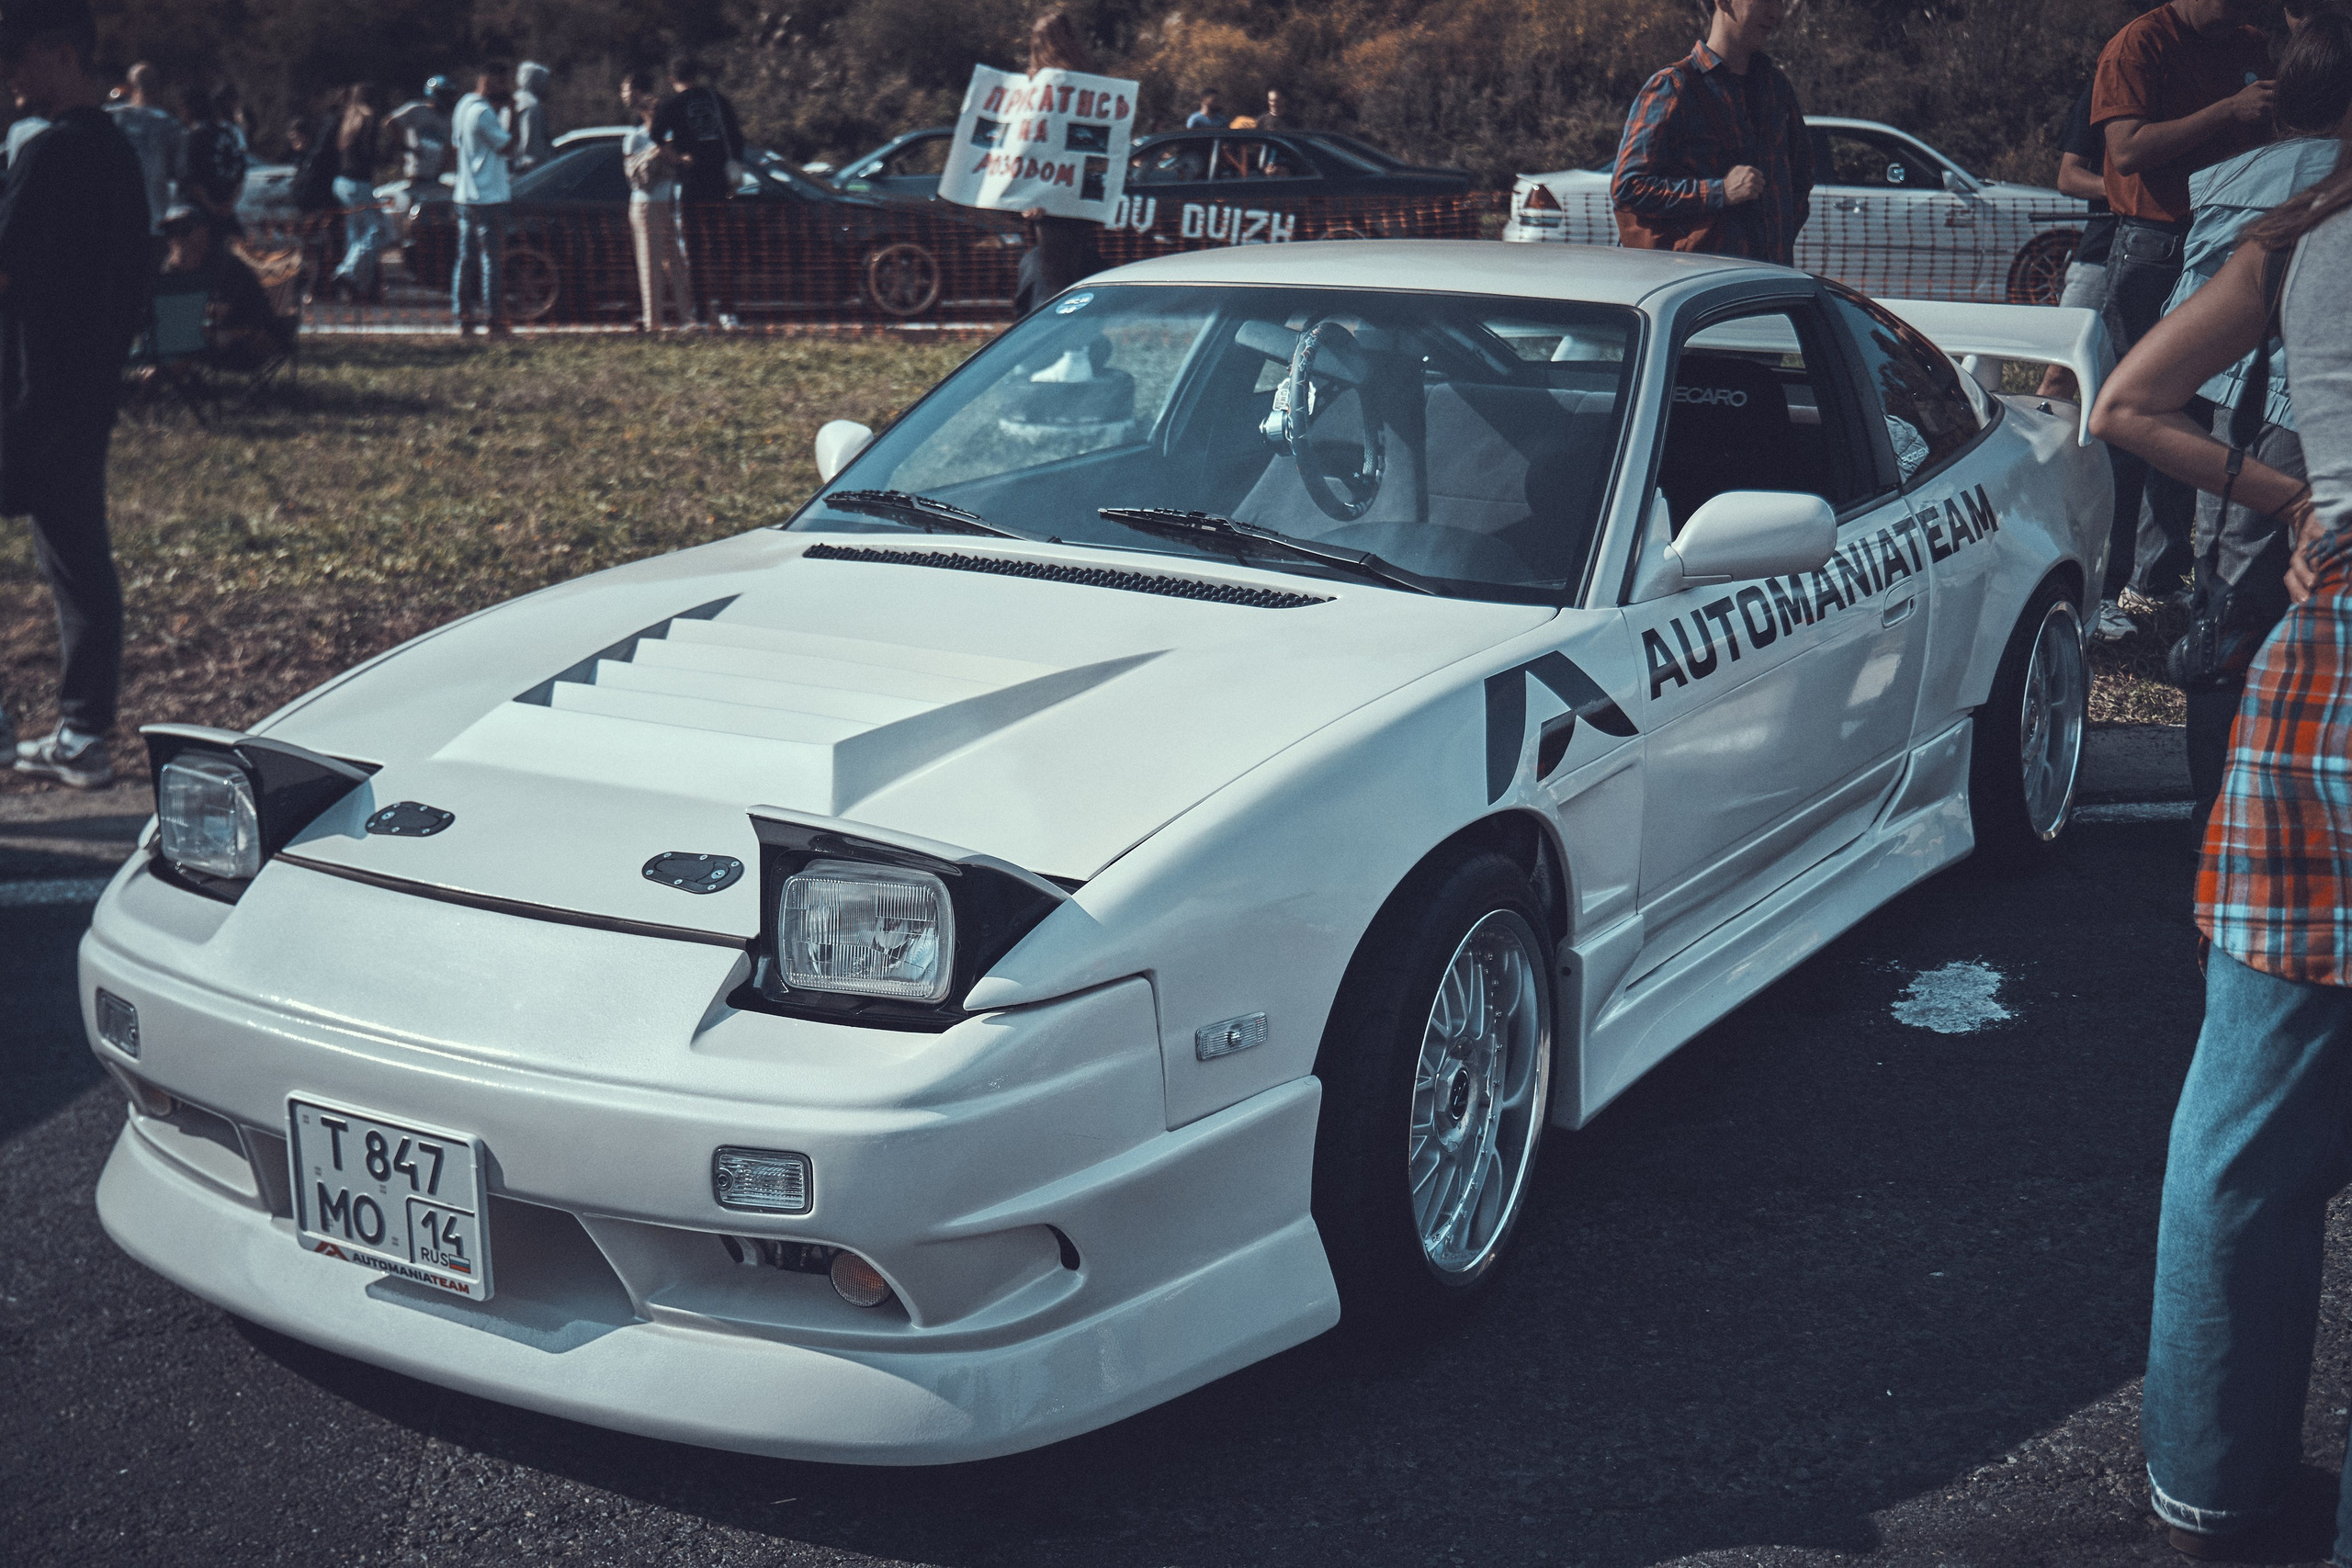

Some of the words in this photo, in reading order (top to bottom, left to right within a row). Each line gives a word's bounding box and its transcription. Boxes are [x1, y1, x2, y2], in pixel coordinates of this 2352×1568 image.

[1018, 118, 1047, 143] НА
[1673, 386, 1747, 408] ECARO
[1641, 484, 2000, 701] AUTOMANIATEAM
[321, 1114, 349, 1171] T
[365, 1130, 446, 1196] 847
[317, 1179, 387, 1247] MO
[421, 1208, 465, 1258] 14
[353, 1252, 470, 1295] AUTOMANIATEAM
[420, 1246, 450, 1268] RUS
